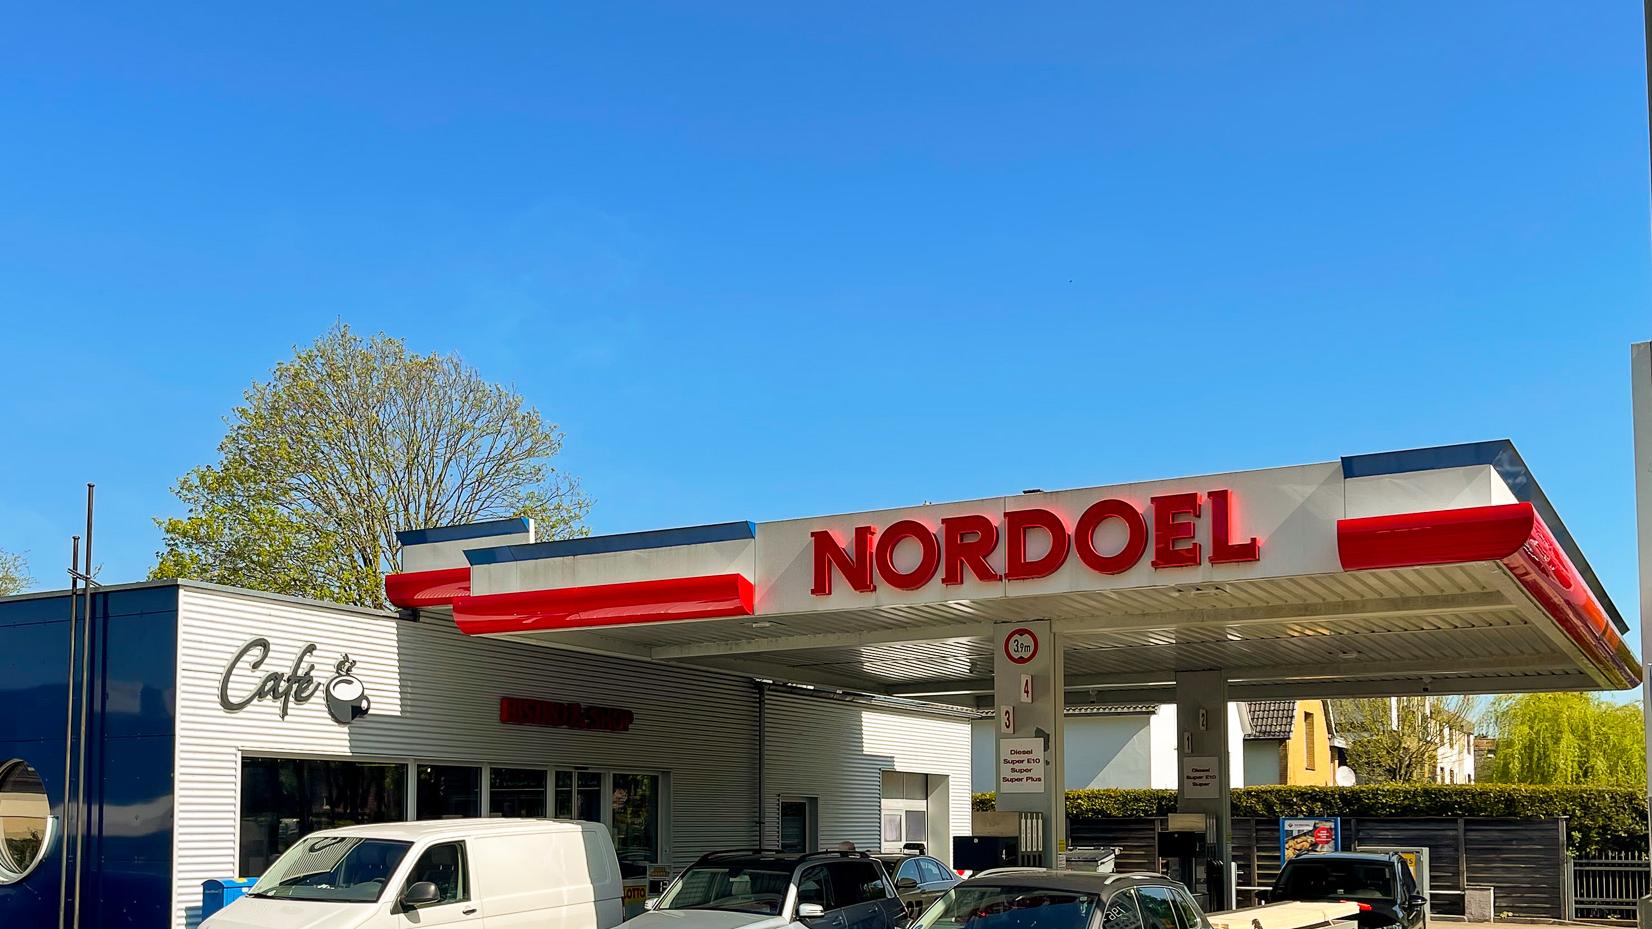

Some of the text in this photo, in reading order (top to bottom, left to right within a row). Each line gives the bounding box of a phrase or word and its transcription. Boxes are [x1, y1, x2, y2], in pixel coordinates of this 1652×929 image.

[811, 489, 1260, 596] NORDOEL
[218, 637, 322, 721] Café
[1024, 679, 1029, 698] 4
[1005, 710, 1010, 728] 3
